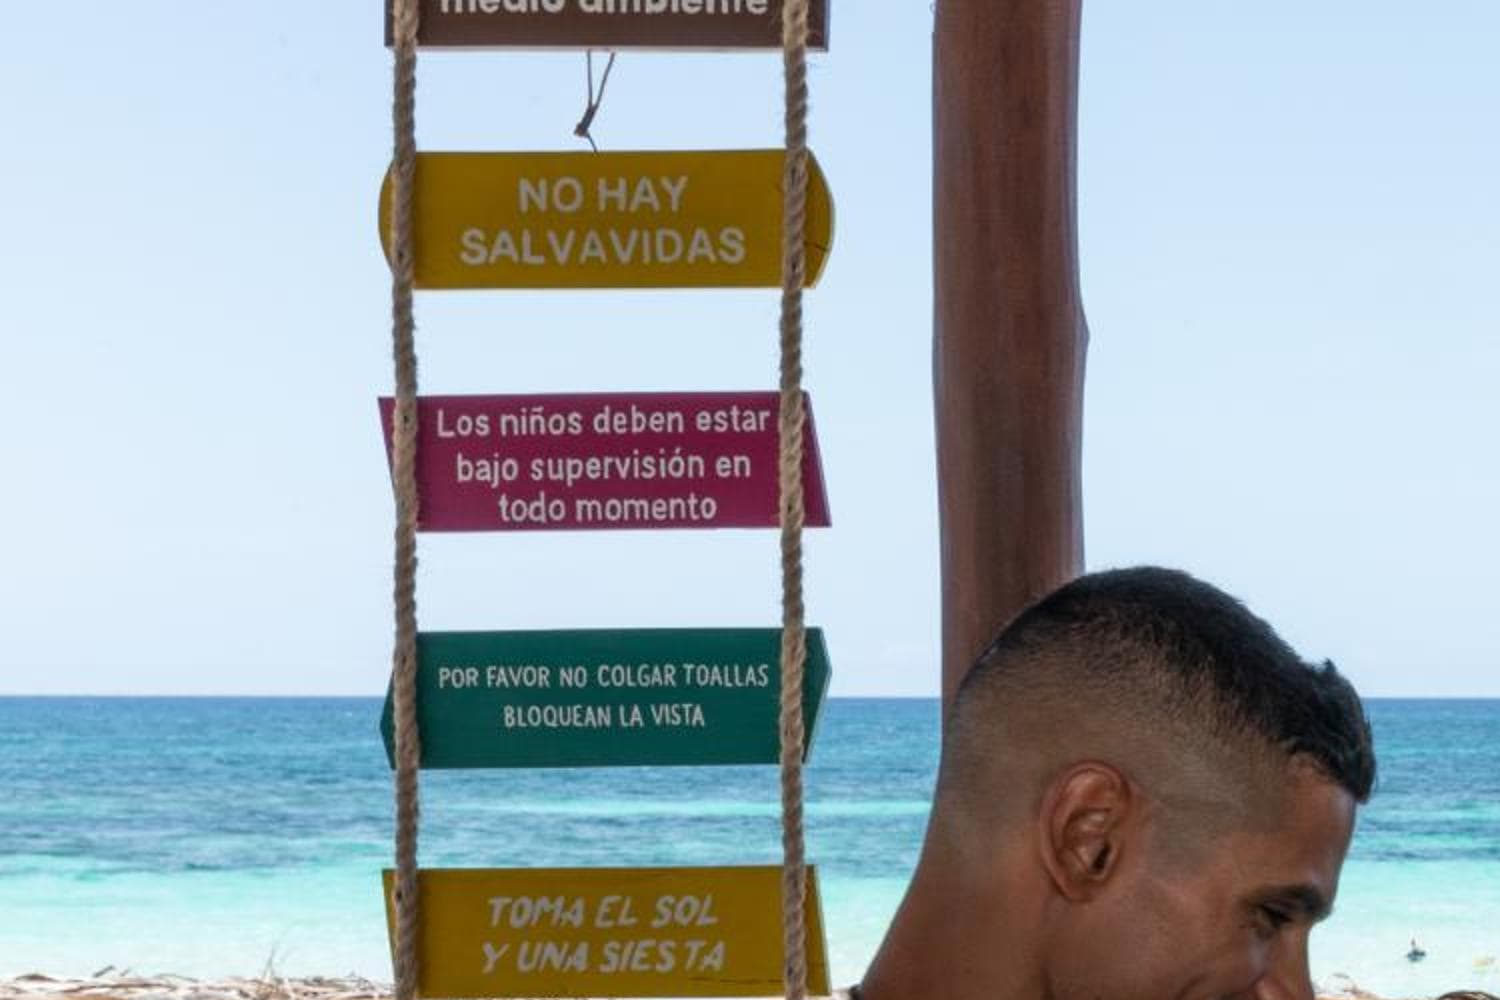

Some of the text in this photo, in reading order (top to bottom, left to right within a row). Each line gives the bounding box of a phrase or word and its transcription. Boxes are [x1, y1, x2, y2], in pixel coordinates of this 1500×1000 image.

[518, 175, 688, 213] NO HAY
[459, 227, 747, 266] SALVAVIDAS
[437, 404, 771, 438] Los niños deben estar
[456, 447, 751, 489] bajo supervisión en
[499, 494, 717, 524] todo momento
[438, 663, 769, 689] POR FAVOR NO COLGAR TOALLAS
[503, 703, 705, 729] BLOQUEAN LA VISTA
[488, 895, 718, 929] TOMA EL SOL
[482, 938, 726, 974] Y UNA SIESTA
